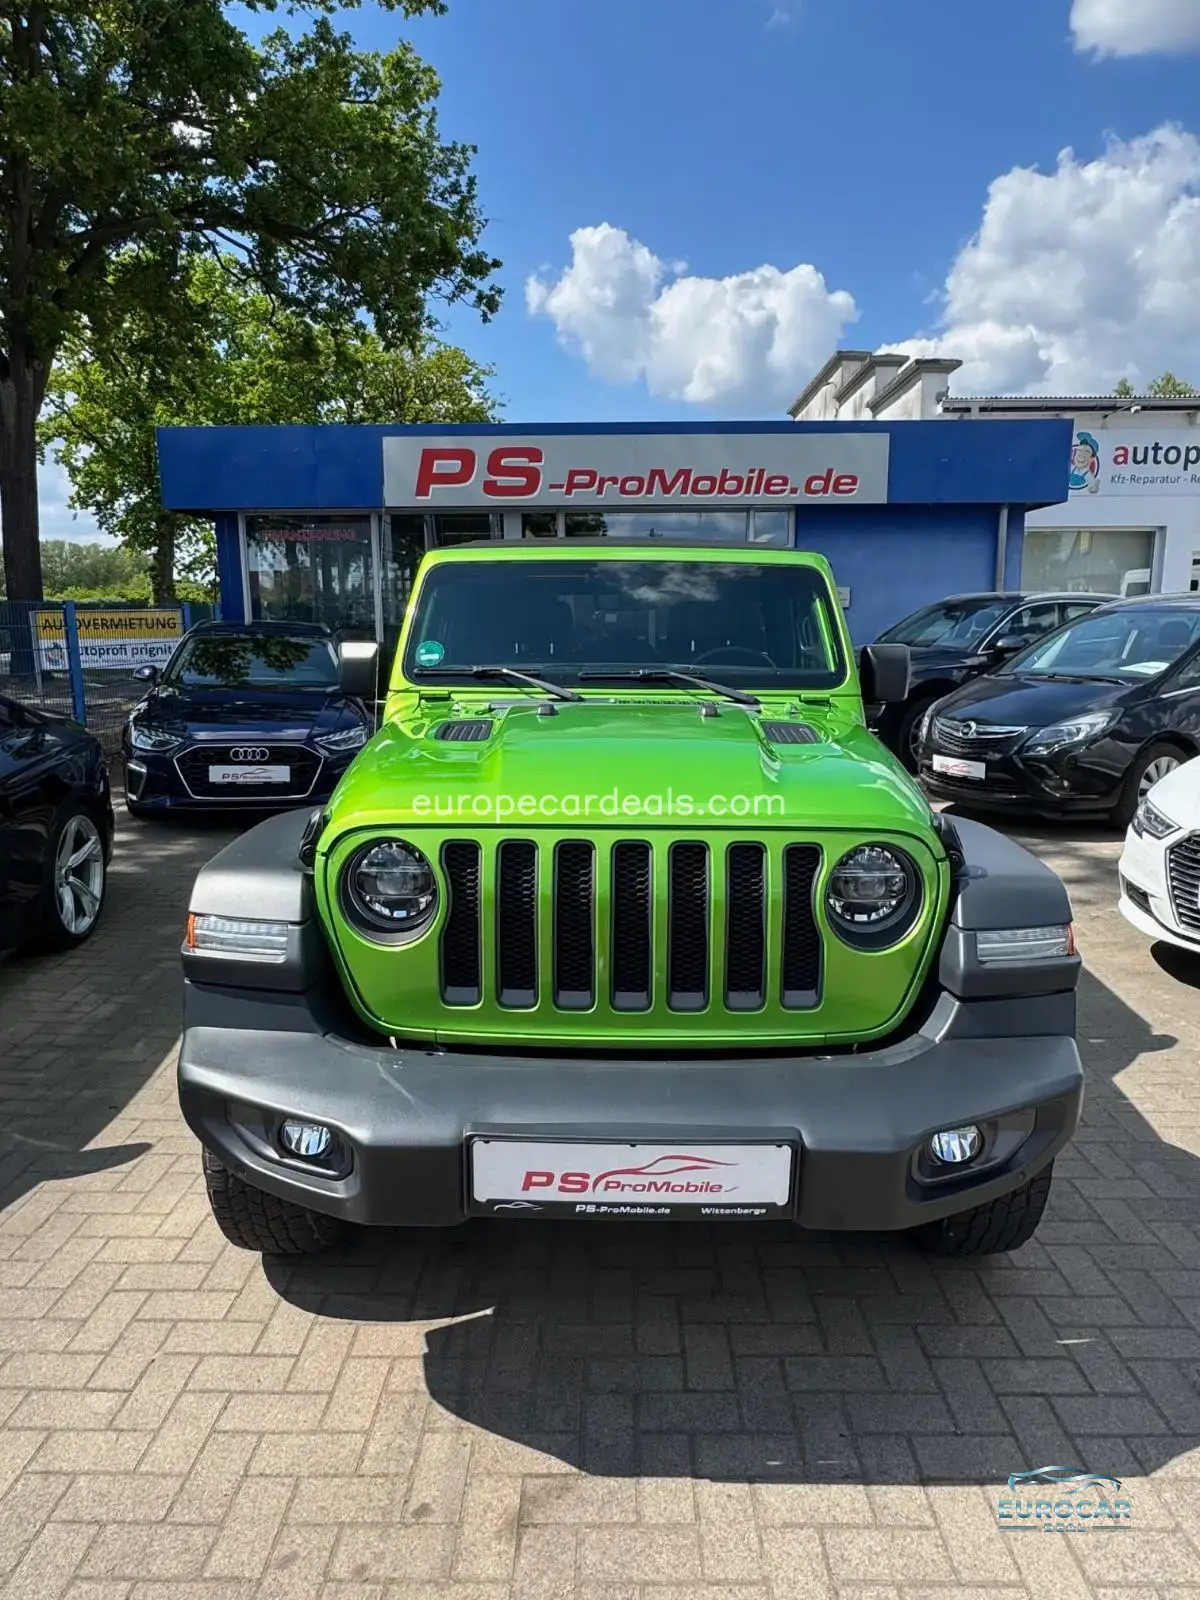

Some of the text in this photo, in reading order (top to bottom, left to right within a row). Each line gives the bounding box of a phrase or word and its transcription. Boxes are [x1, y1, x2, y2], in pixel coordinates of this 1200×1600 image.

[1110, 474, 1181, 485] Kfz-Reparatur
[43, 617, 177, 630] AUOVERMIETUNG
[521, 1171, 723, 1194] PS ProMobile
[575, 1203, 766, 1216] PS-ProMobile.de Wittenberge
